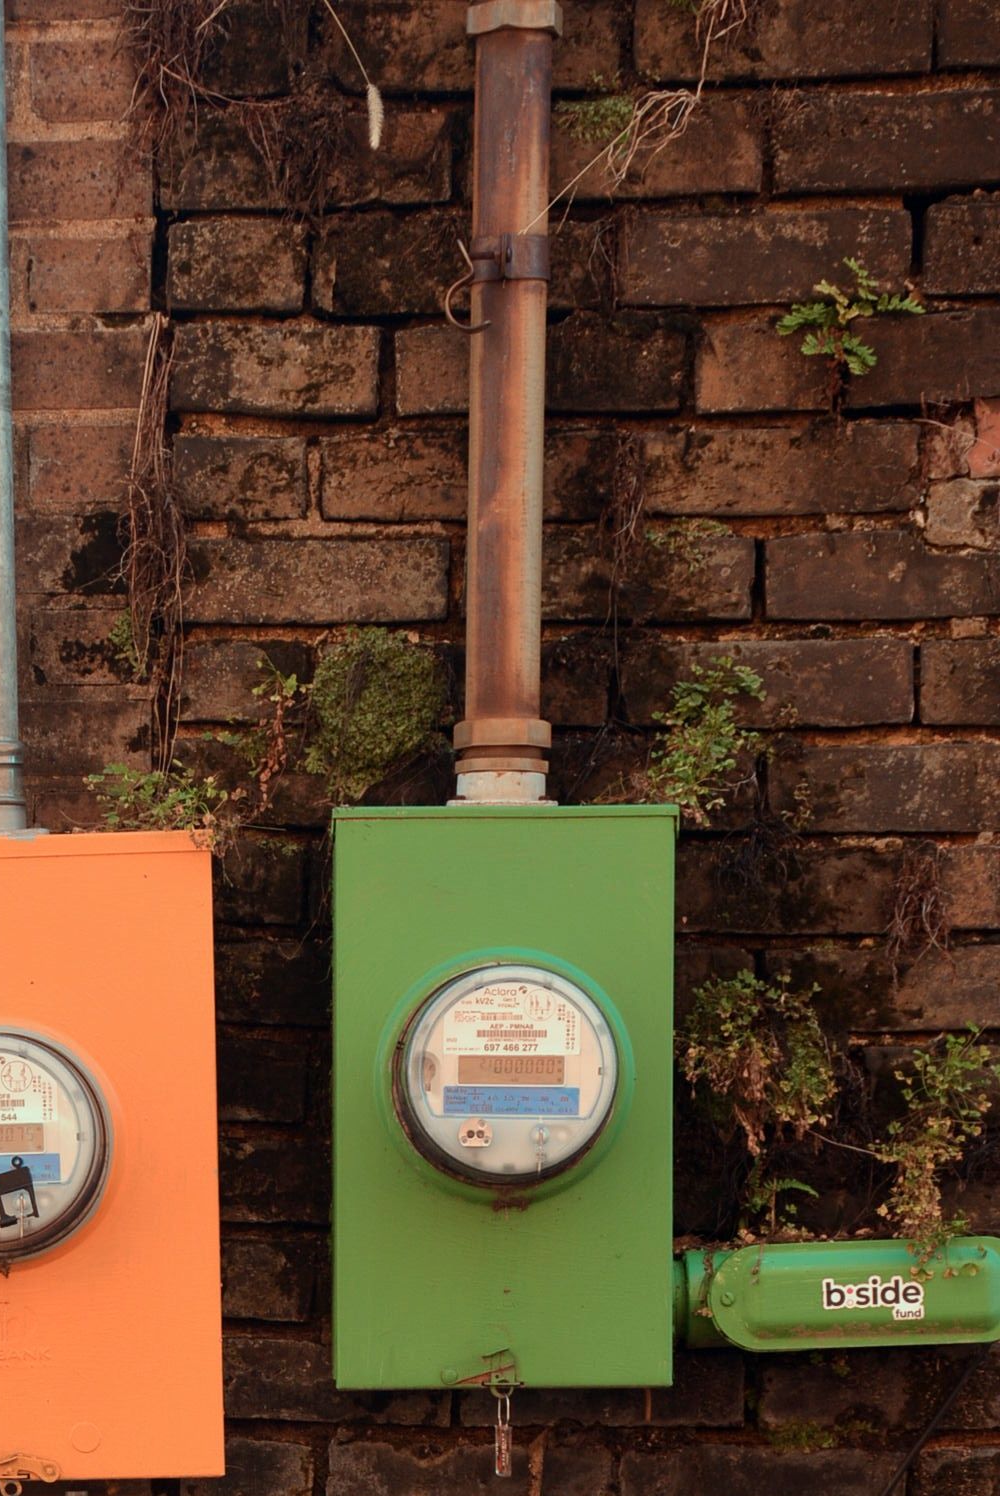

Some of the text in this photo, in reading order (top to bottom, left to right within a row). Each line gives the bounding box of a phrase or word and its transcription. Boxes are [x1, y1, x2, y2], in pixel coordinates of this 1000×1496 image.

[484, 987, 517, 996] Aclara
[484, 1043, 500, 1052] 697
[503, 1043, 519, 1052] 466
[522, 1043, 538, 1052] 277
[1, 1113, 17, 1121] 544
[895, 1308, 922, 1319] fund
